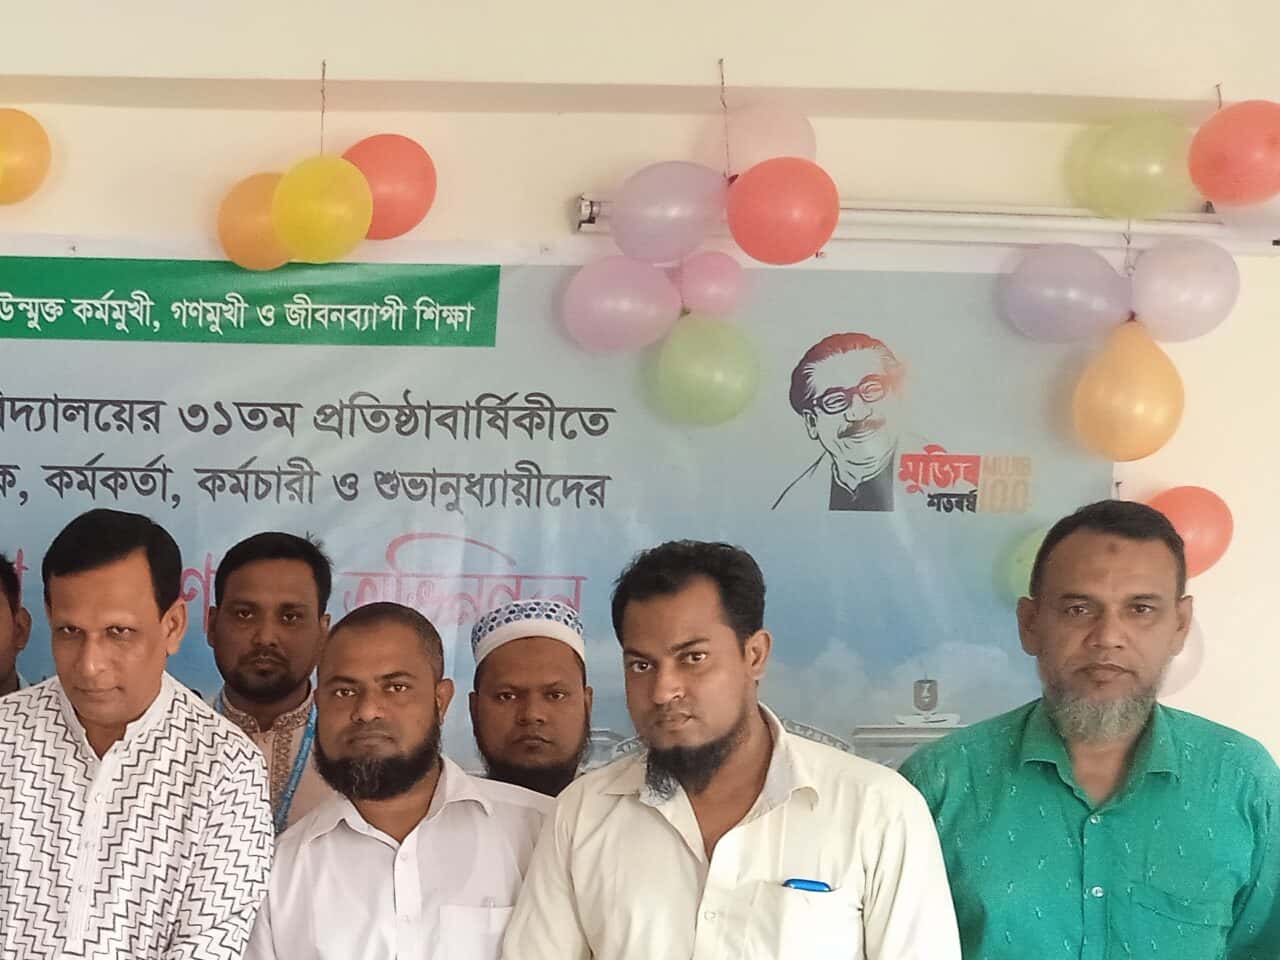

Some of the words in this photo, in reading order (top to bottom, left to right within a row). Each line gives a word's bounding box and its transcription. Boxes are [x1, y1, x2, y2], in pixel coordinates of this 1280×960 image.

[71, 290, 160, 333] কর্মমুখী,
[170, 292, 249, 334] গণমুখী
[257, 303, 275, 327] ও
[283, 294, 407, 332] জীবনব্যাপী
[413, 295, 475, 332] শিক্ষা
[178, 400, 303, 438] ৩১তম
[313, 388, 617, 442] প্রতিষ্ঠাবার্ষিকীতে
[40, 453, 181, 509] কর্মকর্তা,
[193, 455, 322, 504] কর্মচারী
[332, 471, 359, 502] ও
[374, 459, 613, 515] শুভানুধ্যায়ীদের
